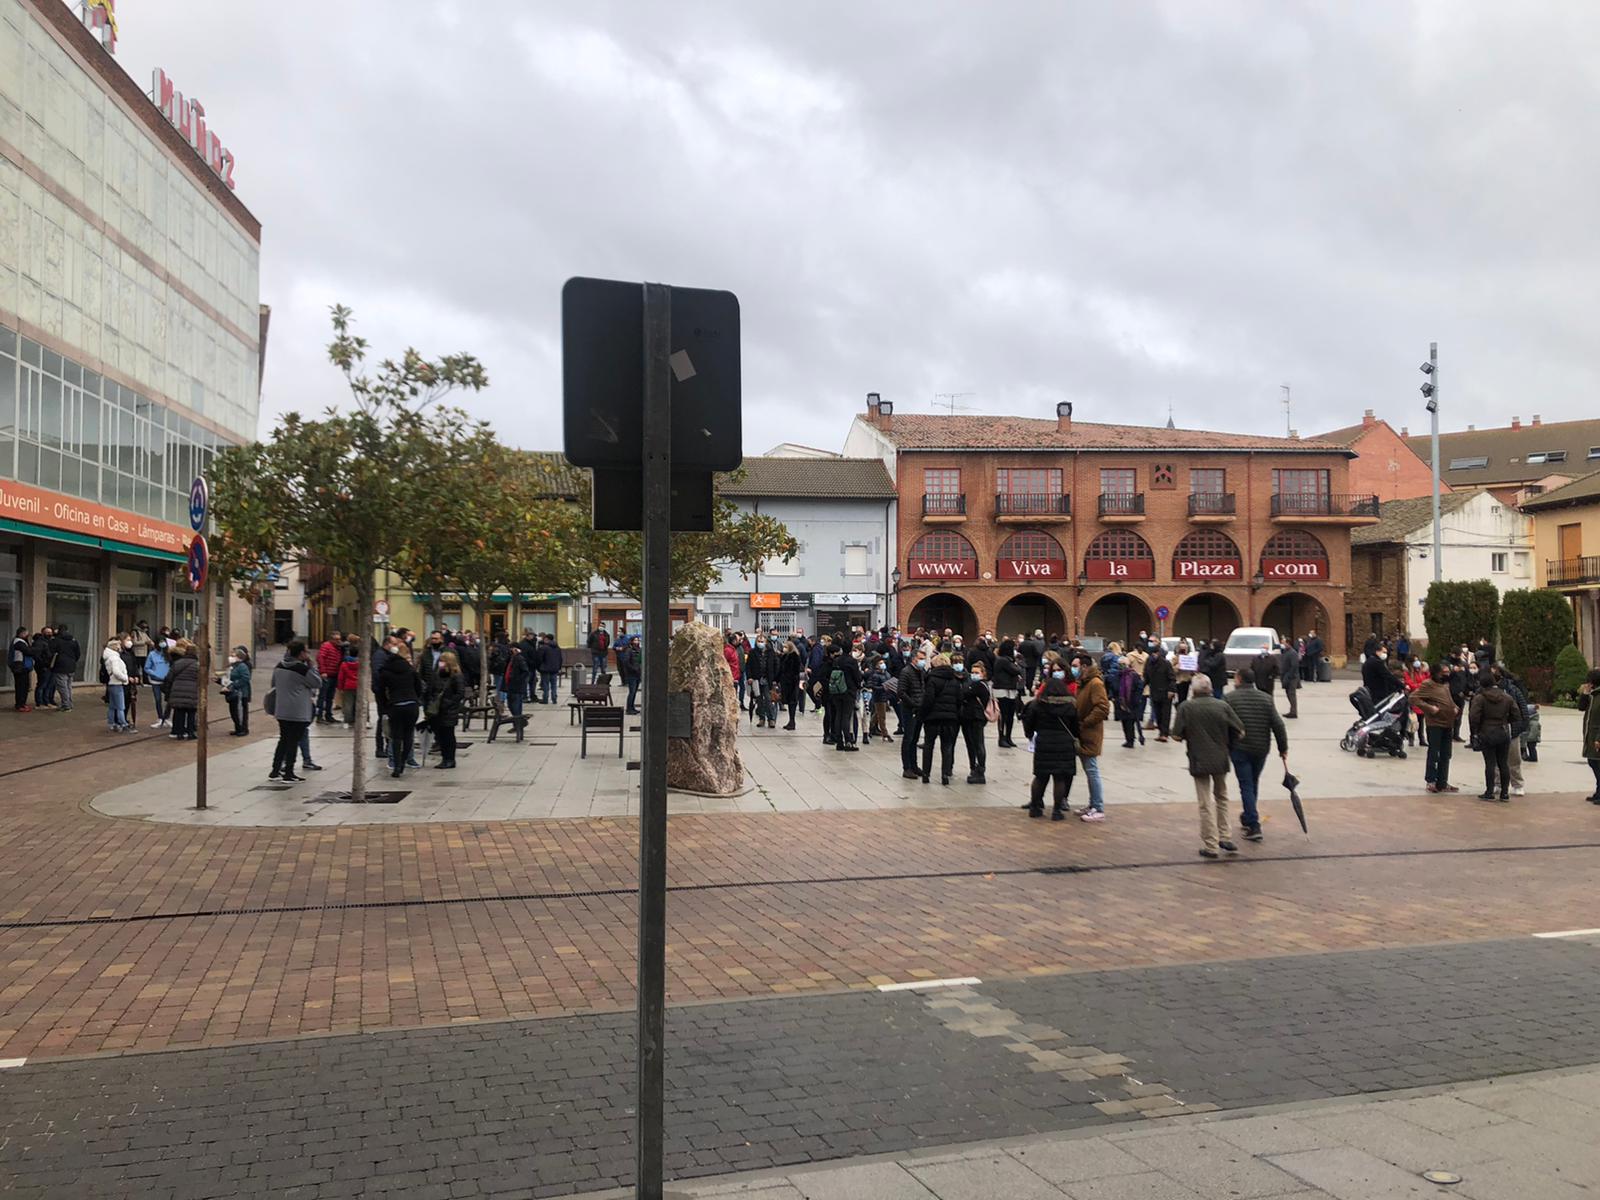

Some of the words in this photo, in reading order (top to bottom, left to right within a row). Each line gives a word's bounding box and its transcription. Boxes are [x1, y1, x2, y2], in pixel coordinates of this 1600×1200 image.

[0, 488, 40, 513] Juvenil
[54, 502, 90, 525] Oficina
[92, 515, 105, 528] en
[107, 515, 129, 534] Casa
[137, 523, 175, 544] Lámparas
[918, 562, 968, 575] www.
[1011, 560, 1051, 576] Viva
[1109, 561, 1128, 576] la
[1180, 561, 1235, 576] Plaza
[1268, 562, 1318, 576] .com
